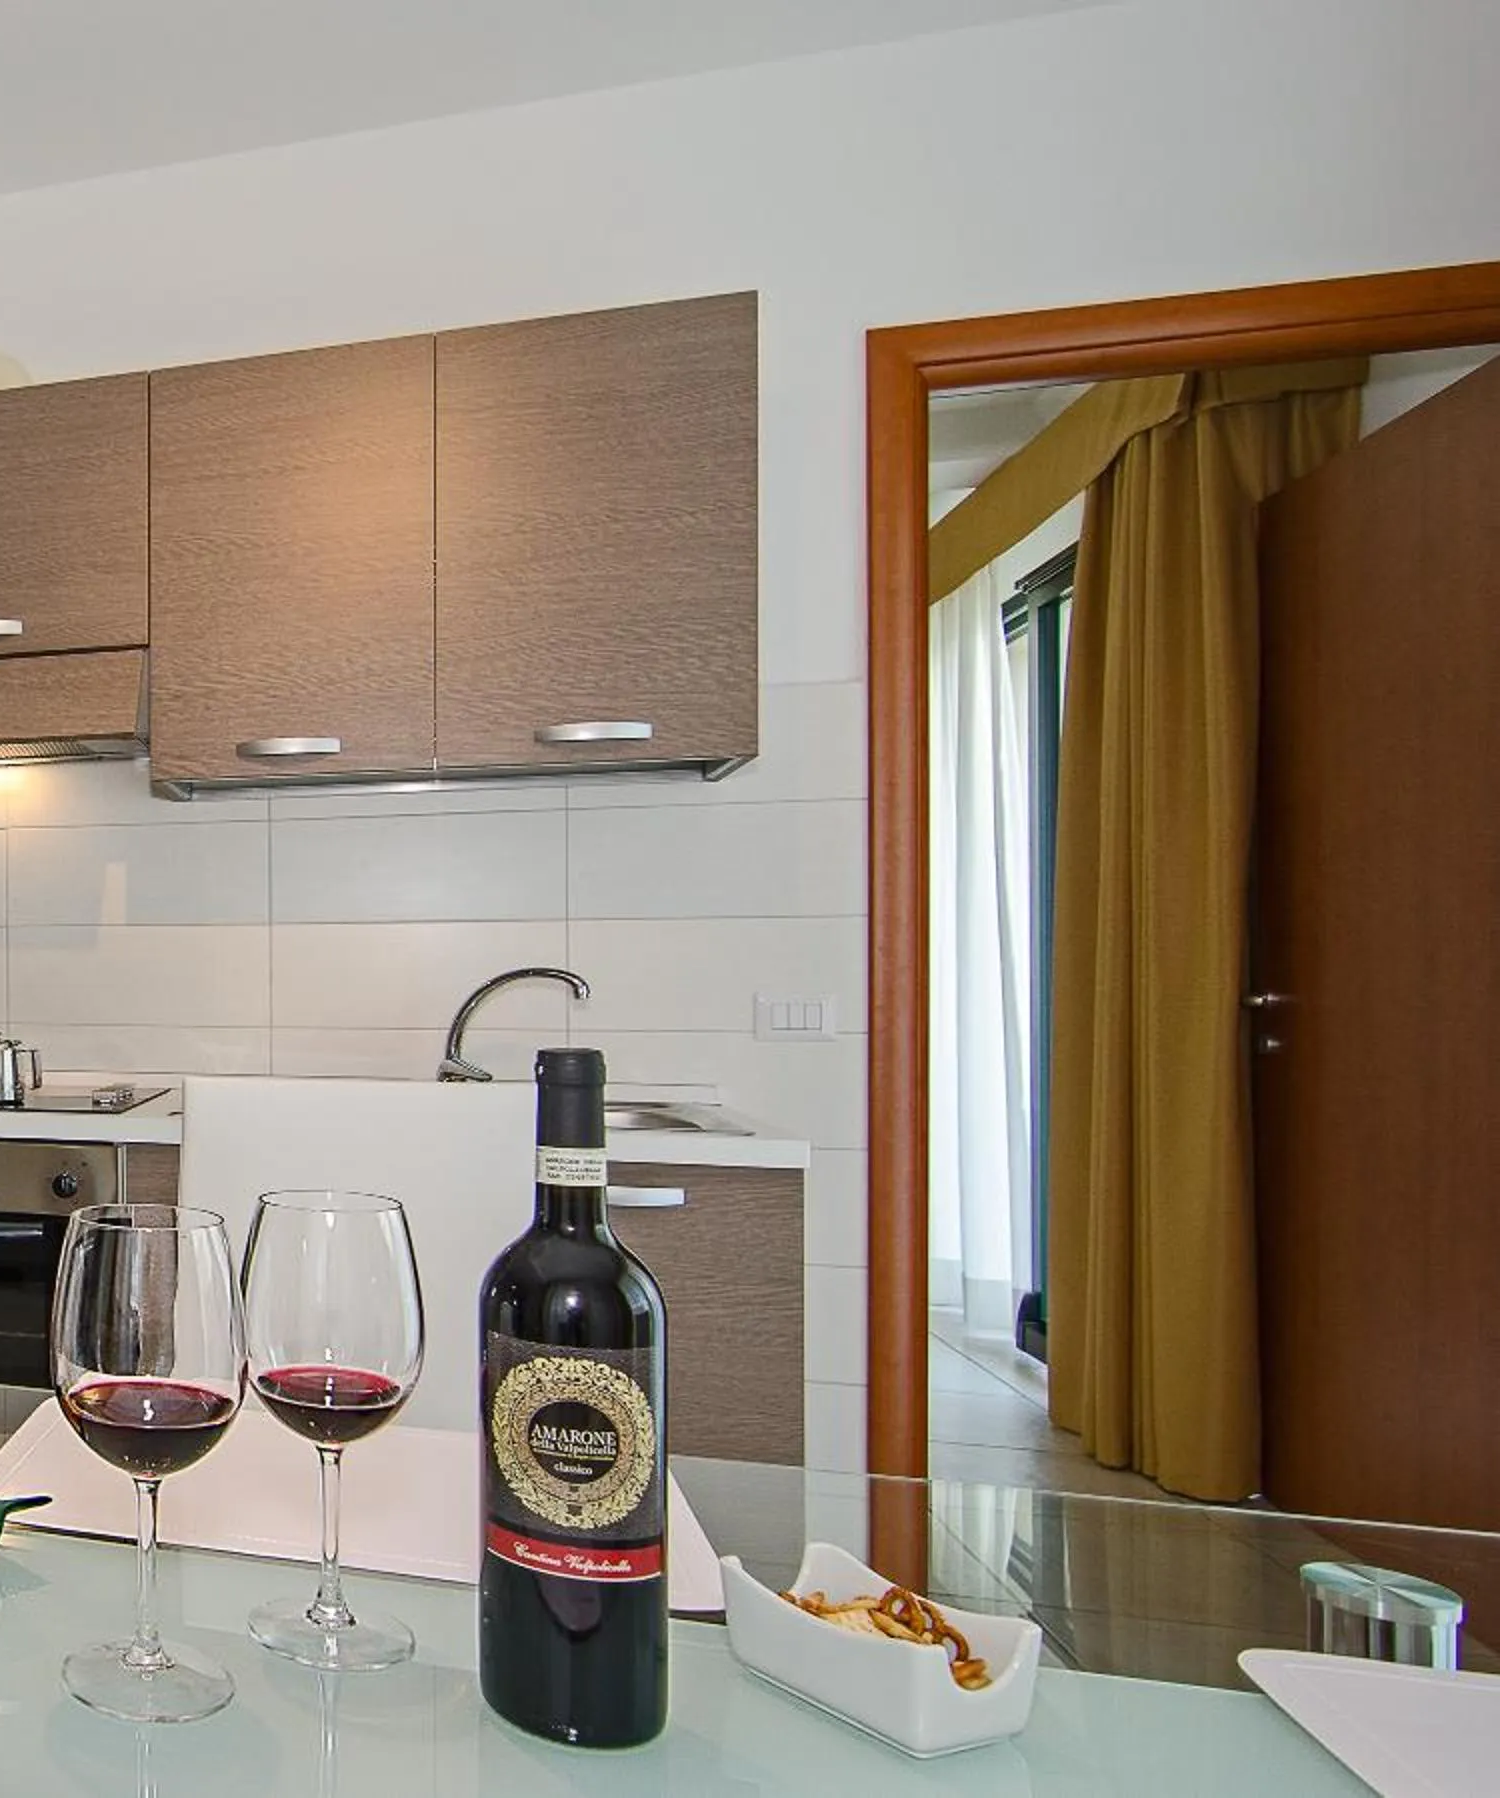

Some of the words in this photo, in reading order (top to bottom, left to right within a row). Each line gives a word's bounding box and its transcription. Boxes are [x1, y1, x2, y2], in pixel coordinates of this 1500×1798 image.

[531, 1424, 617, 1446] AMARONE
[530, 1437, 555, 1451] della
[556, 1441, 617, 1456] Valpolicella
[553, 1462, 593, 1475] classico
